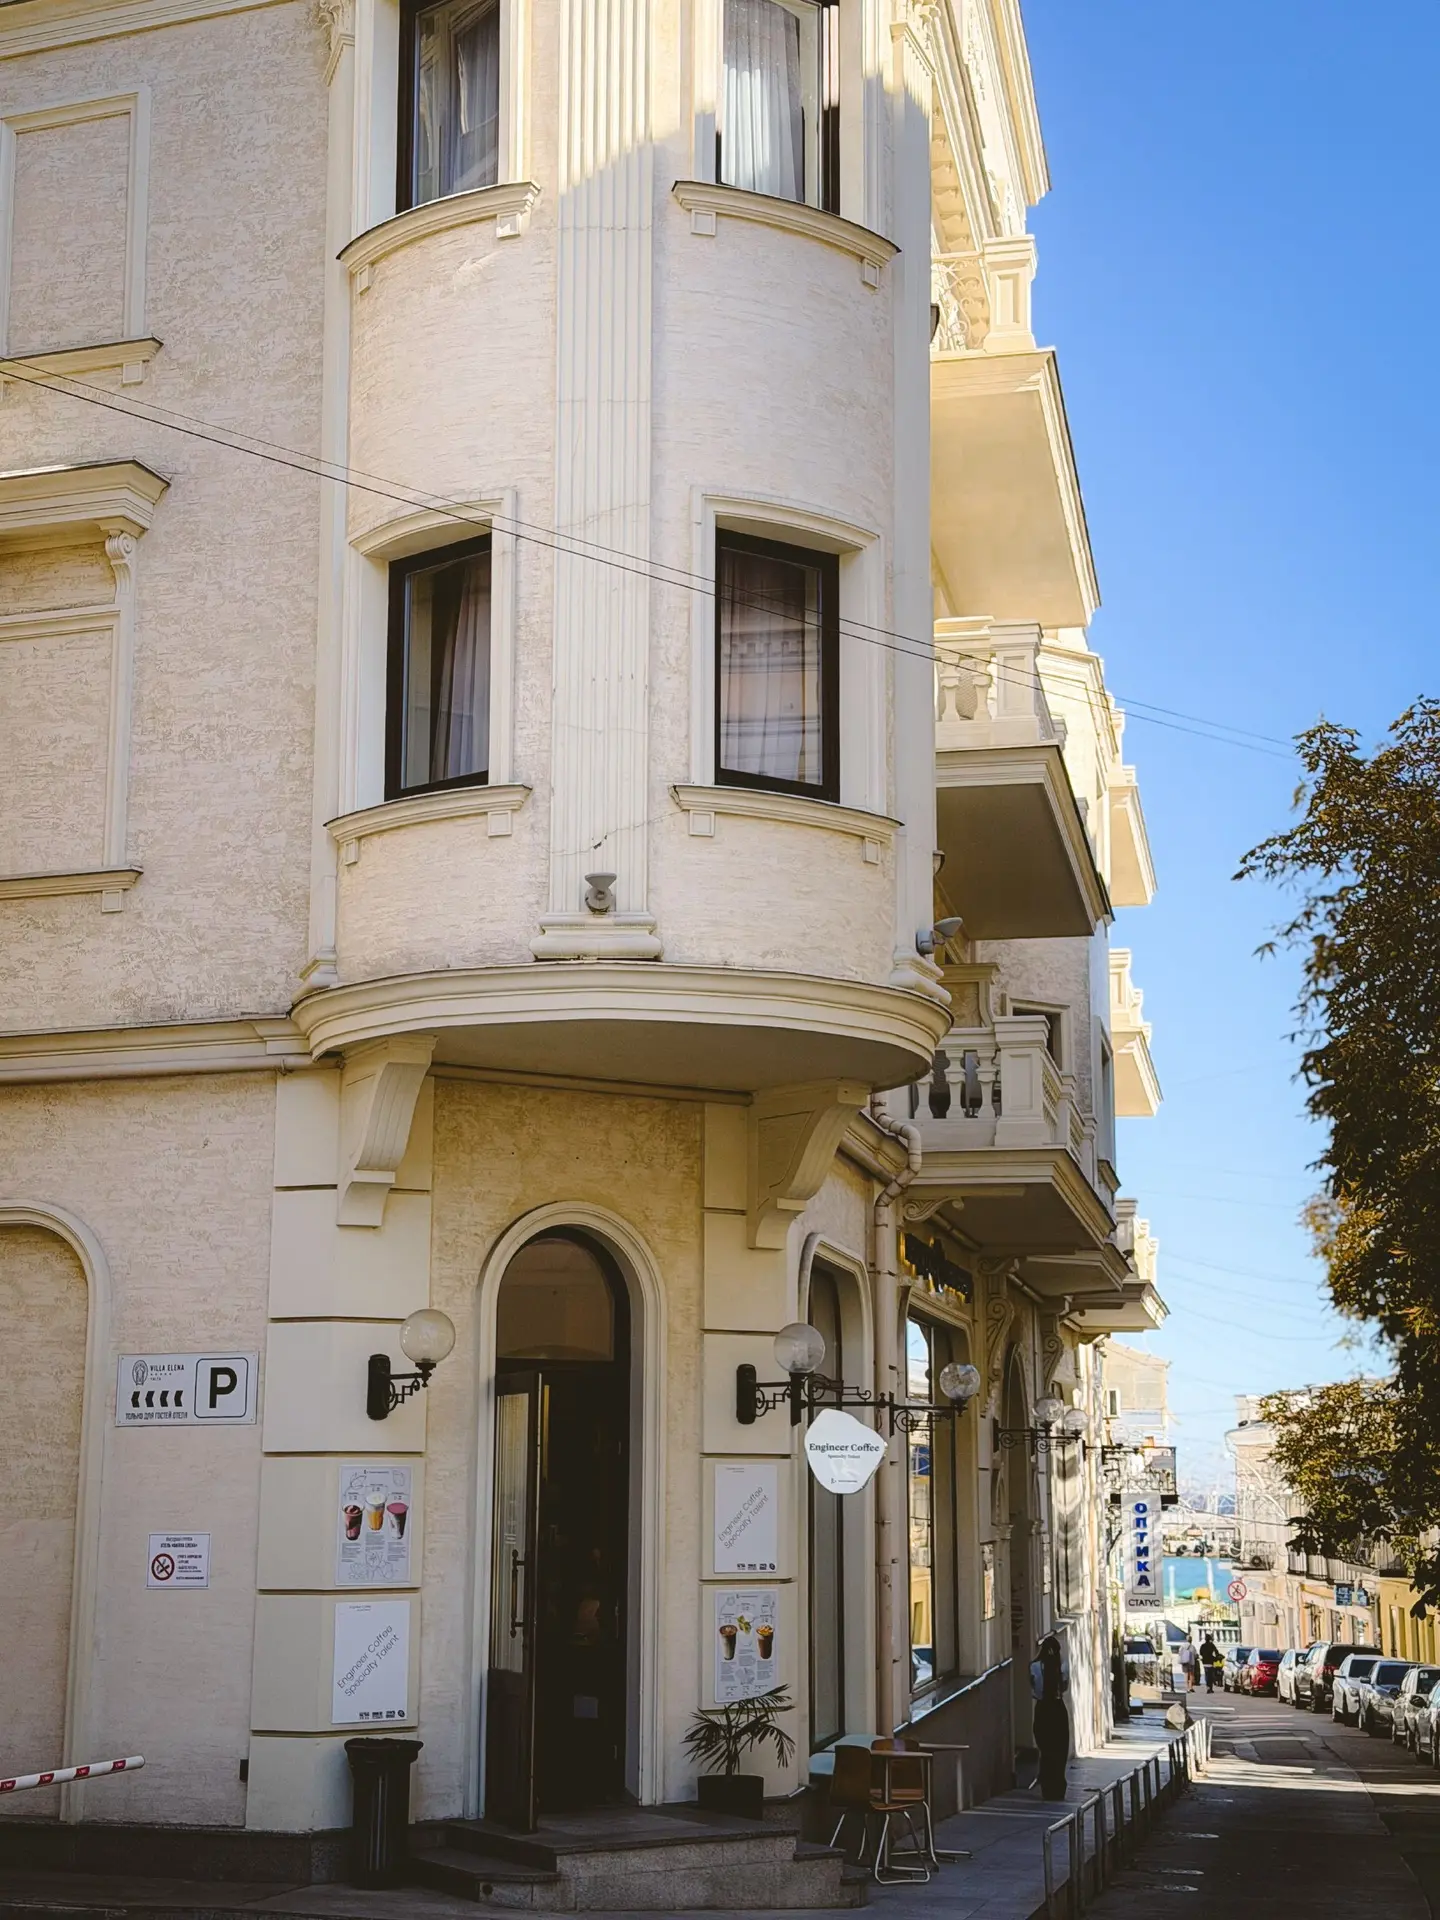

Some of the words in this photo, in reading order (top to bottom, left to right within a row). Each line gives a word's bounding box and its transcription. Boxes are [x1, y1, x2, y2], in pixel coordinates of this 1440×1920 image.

[150, 1364, 165, 1372] VILLA
[167, 1364, 185, 1372] ELENA
[209, 1367, 238, 1409] P
[809, 1442, 849, 1454] Engineer
[850, 1442, 880, 1452] Coffee
[718, 1510, 744, 1542] Engineer
[742, 1486, 763, 1511] Coffee
[724, 1515, 752, 1549] Specialty
[1134, 1502, 1151, 1587] ОПТИКА
[1128, 1599, 1160, 1607] СТАТУС
[337, 1652, 369, 1689] Engineer
[367, 1625, 393, 1654] Coffee
[344, 1660, 379, 1697] Specialty
[375, 1634, 401, 1660] Talent
